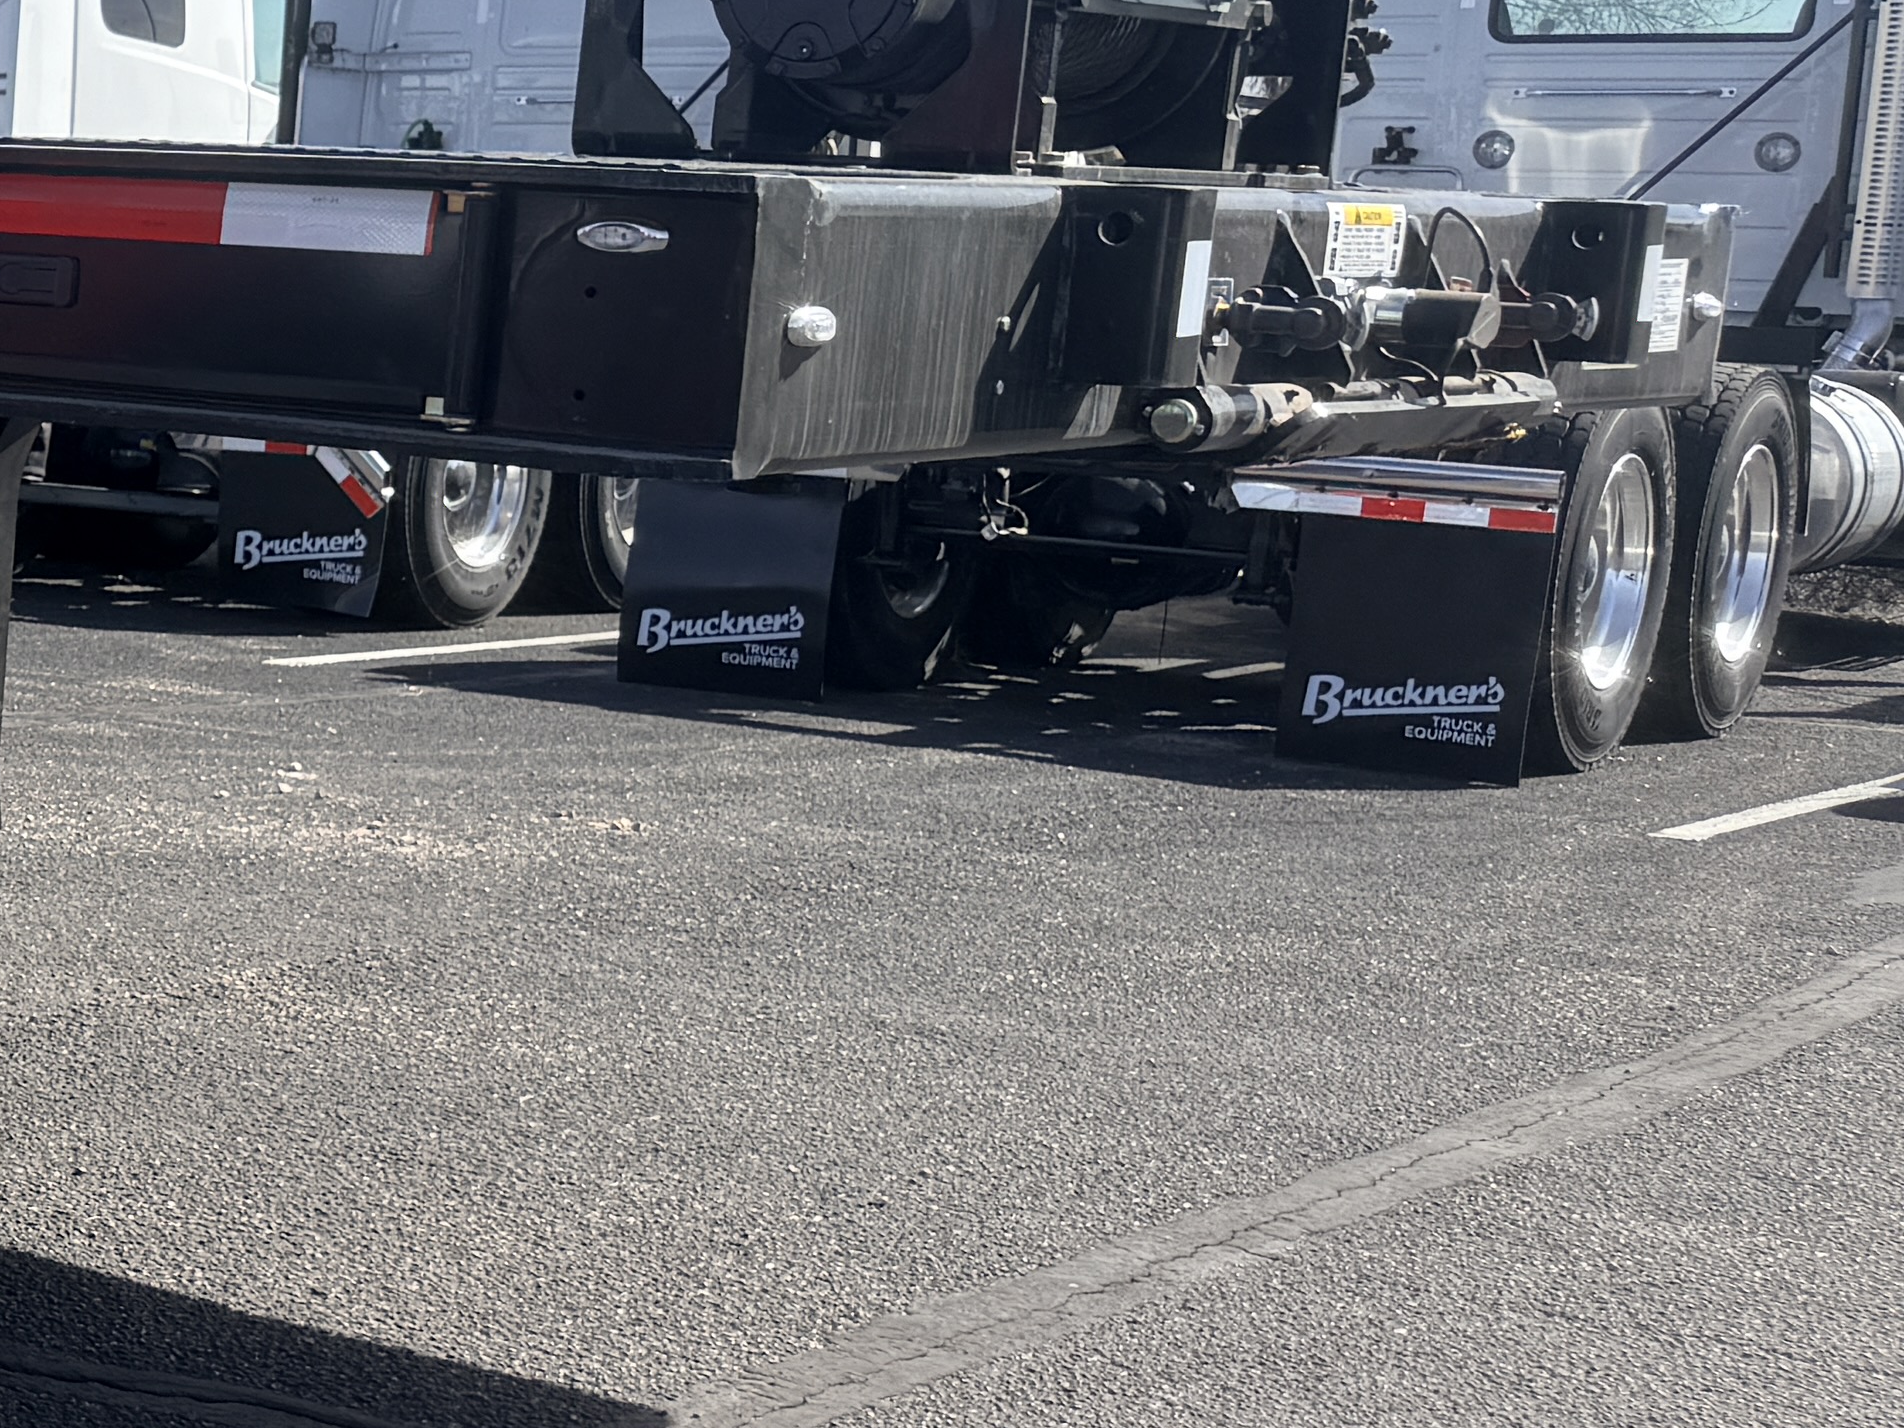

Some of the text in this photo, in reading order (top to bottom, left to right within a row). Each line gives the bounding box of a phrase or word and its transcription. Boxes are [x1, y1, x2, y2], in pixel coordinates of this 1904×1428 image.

[234, 528, 368, 570] Bruckner's
[303, 567, 362, 585] EQUIPMENT
[320, 560, 353, 574] TRUCK
[636, 605, 805, 654] Bruckner's
[721, 651, 799, 670] EQUIPMENT
[743, 643, 800, 659] TRUCK &
[1301, 674, 1505, 725] Bruckner's
[1432, 715, 1497, 736] TRUCK &
[1404, 725, 1496, 748] EQUIPMENT
